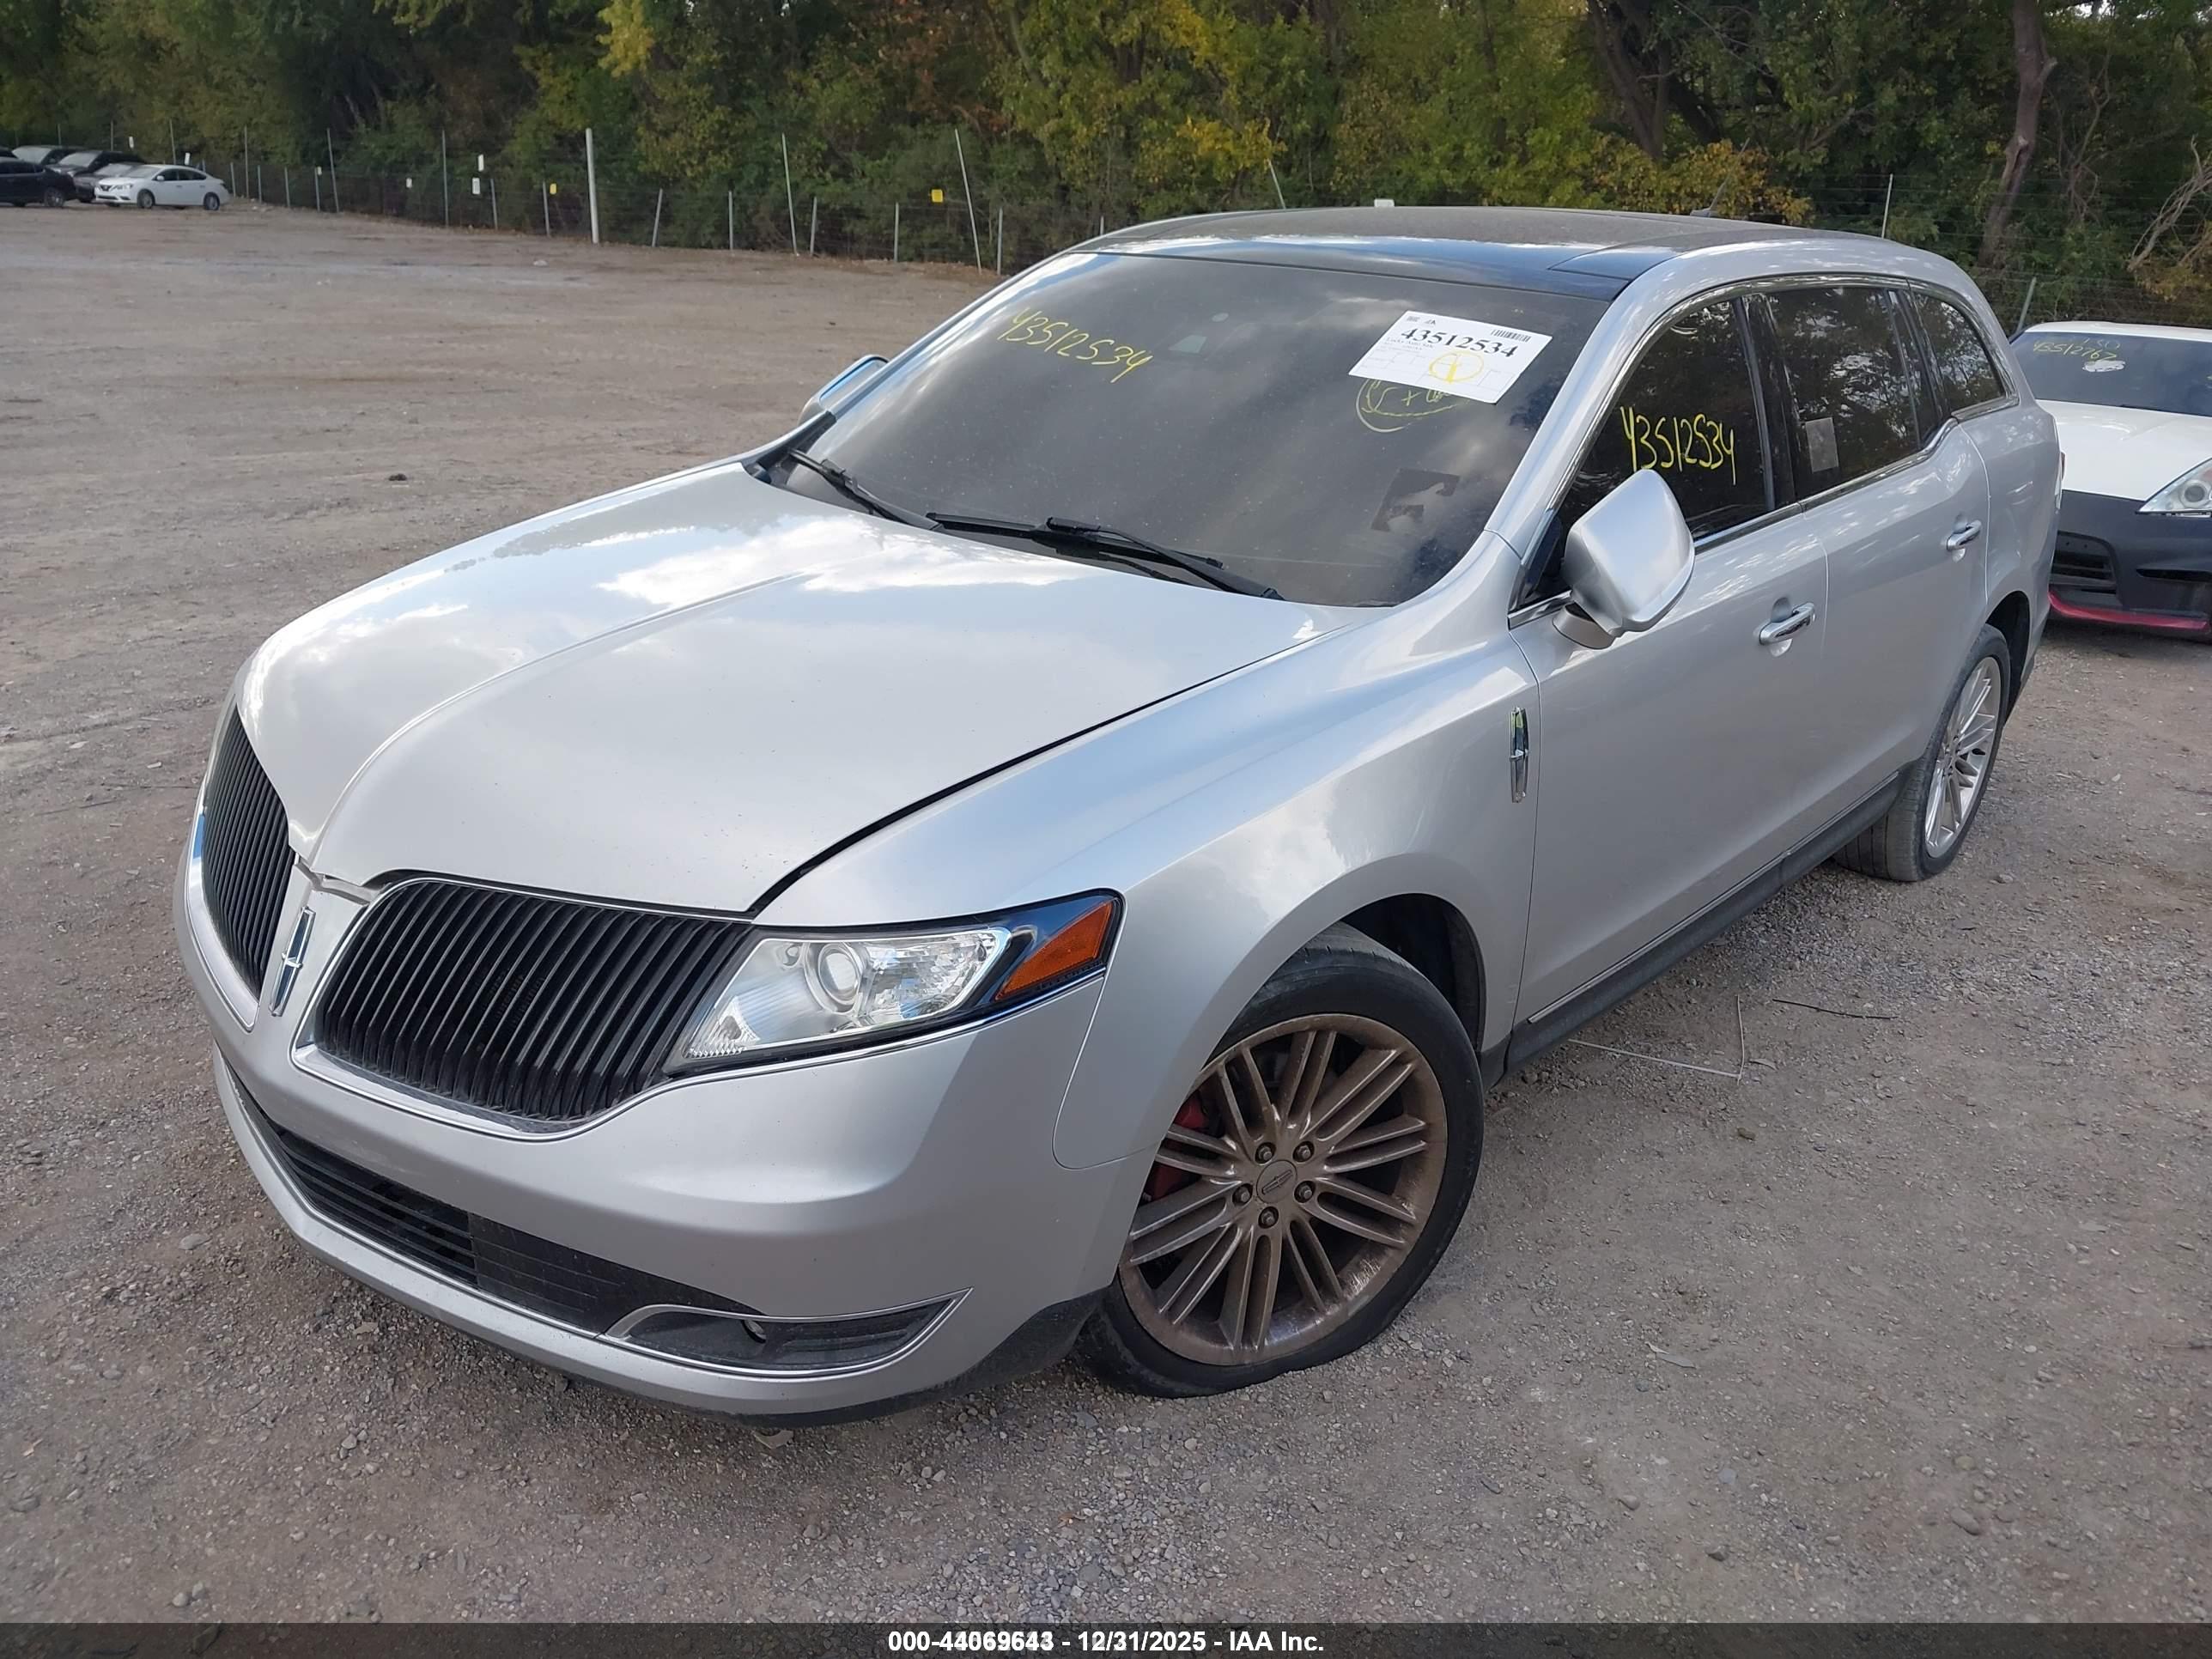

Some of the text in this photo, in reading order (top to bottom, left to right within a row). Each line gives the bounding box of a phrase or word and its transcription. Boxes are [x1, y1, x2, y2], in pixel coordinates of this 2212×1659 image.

[997, 307, 1153, 383] 43512534
[1401, 328, 1519, 358] 43512534
[1620, 406, 1736, 486] 43512534
